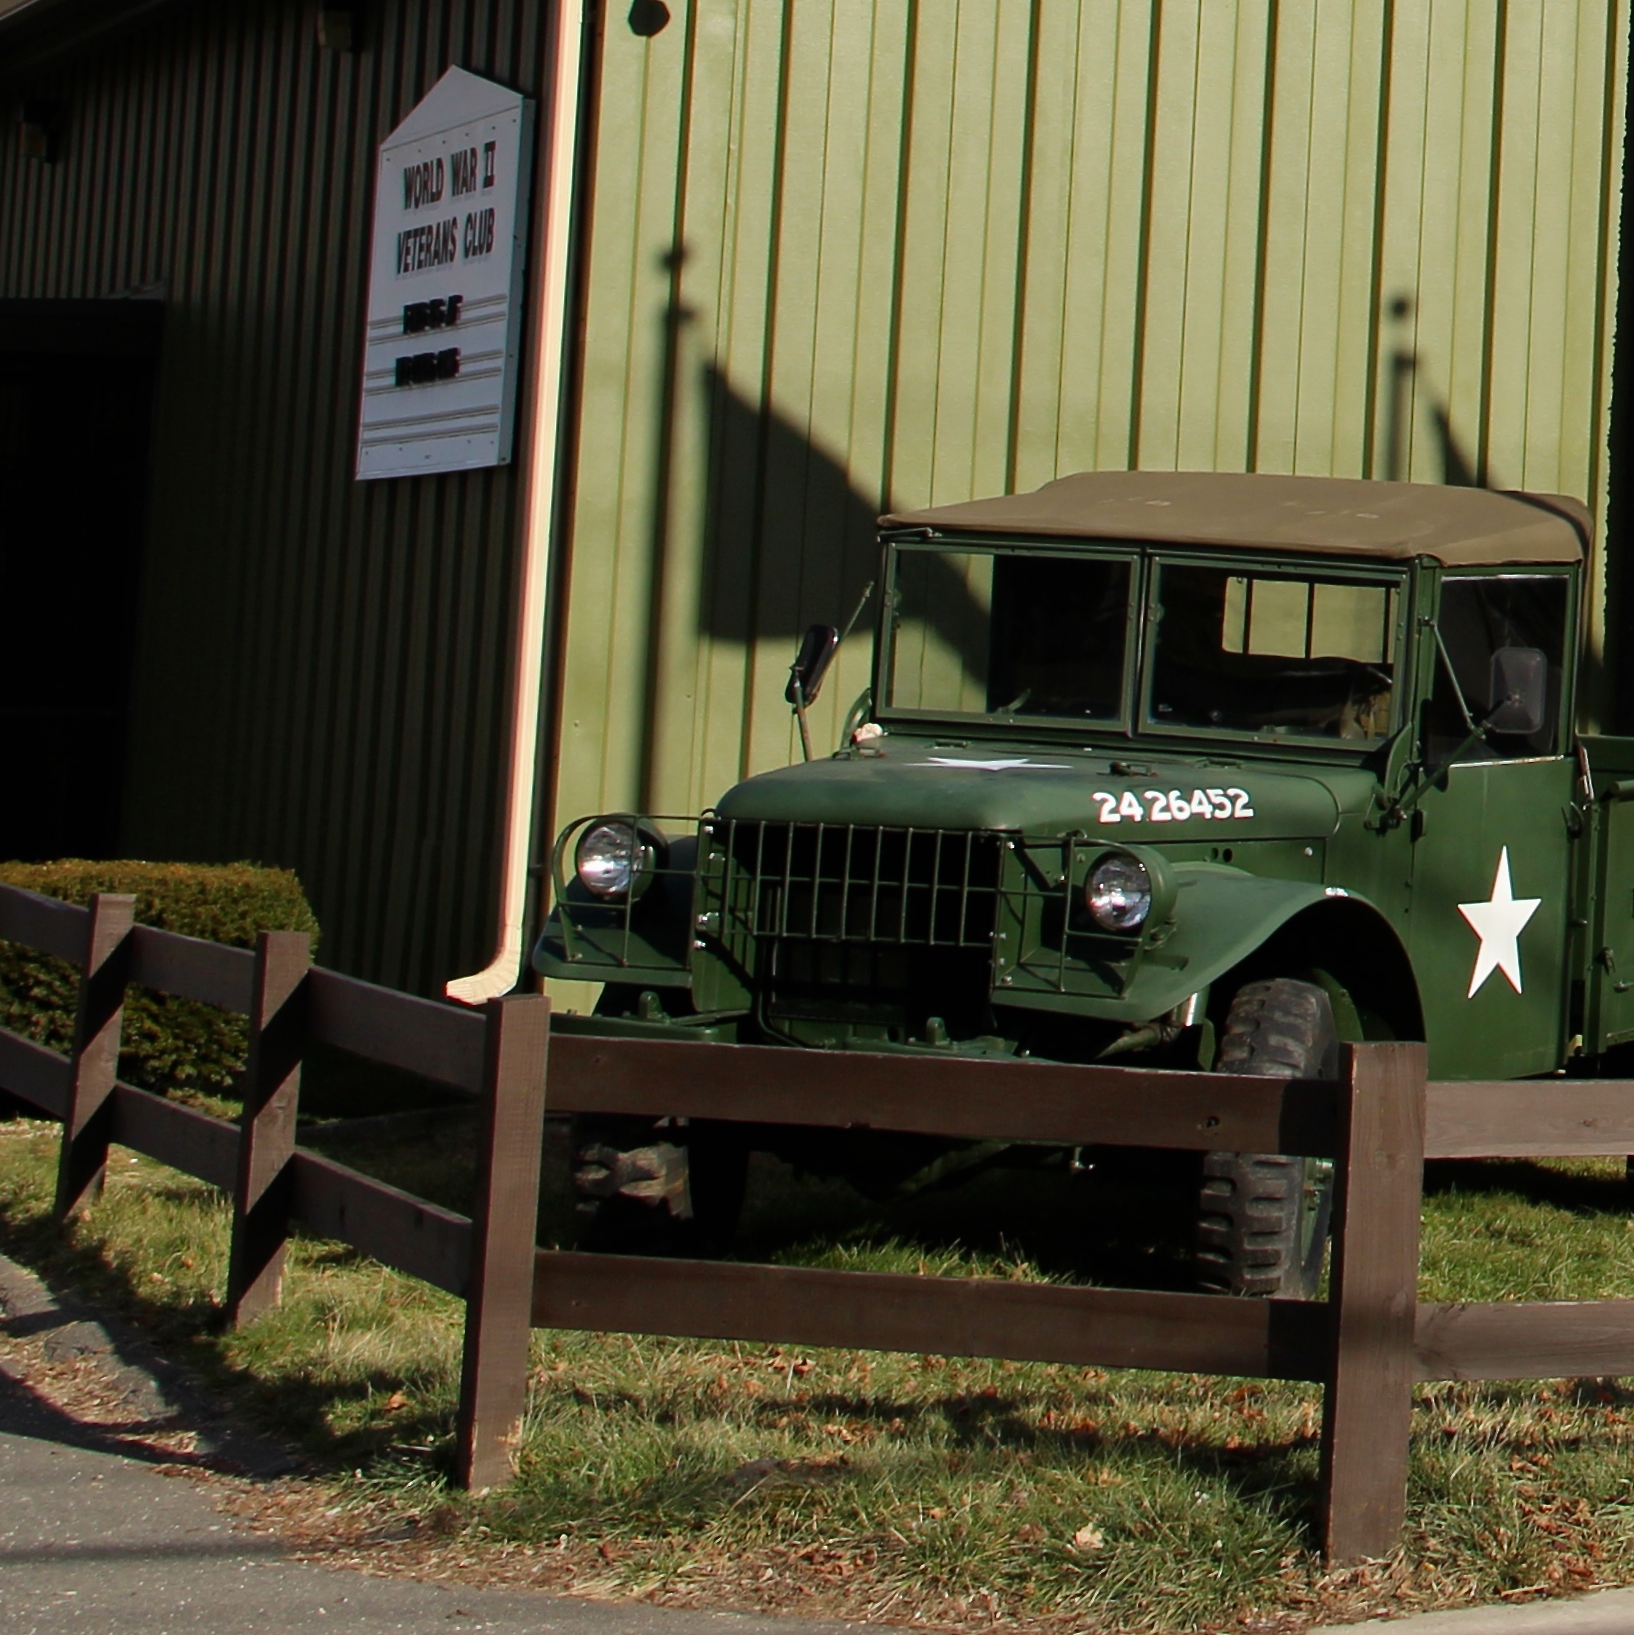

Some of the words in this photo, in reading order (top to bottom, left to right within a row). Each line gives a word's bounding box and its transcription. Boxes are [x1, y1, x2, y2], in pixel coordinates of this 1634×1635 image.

[403, 156, 444, 210] WORLD
[450, 147, 478, 197] WAR
[482, 140, 496, 189] II
[397, 216, 458, 275] VETERANS
[463, 207, 495, 259] CLUB
